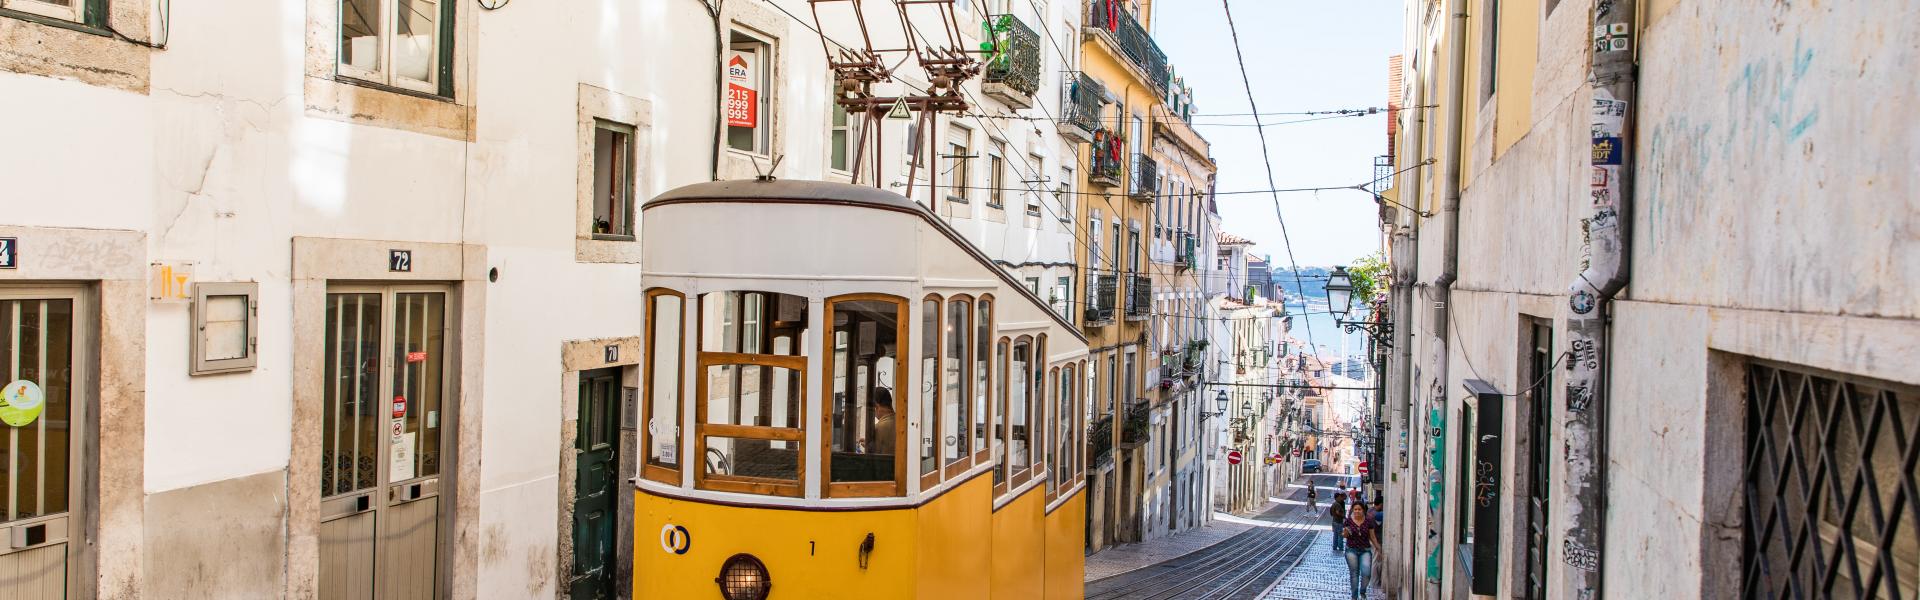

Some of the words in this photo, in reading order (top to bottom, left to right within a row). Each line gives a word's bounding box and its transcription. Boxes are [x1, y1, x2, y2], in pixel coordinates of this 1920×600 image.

[729, 68, 746, 76] ERA
[729, 89, 748, 100] 215
[729, 100, 748, 110] 999
[729, 110, 748, 120] 995
[394, 251, 408, 270] 72
[608, 346, 617, 361] 70
[809, 540, 815, 556] 1
